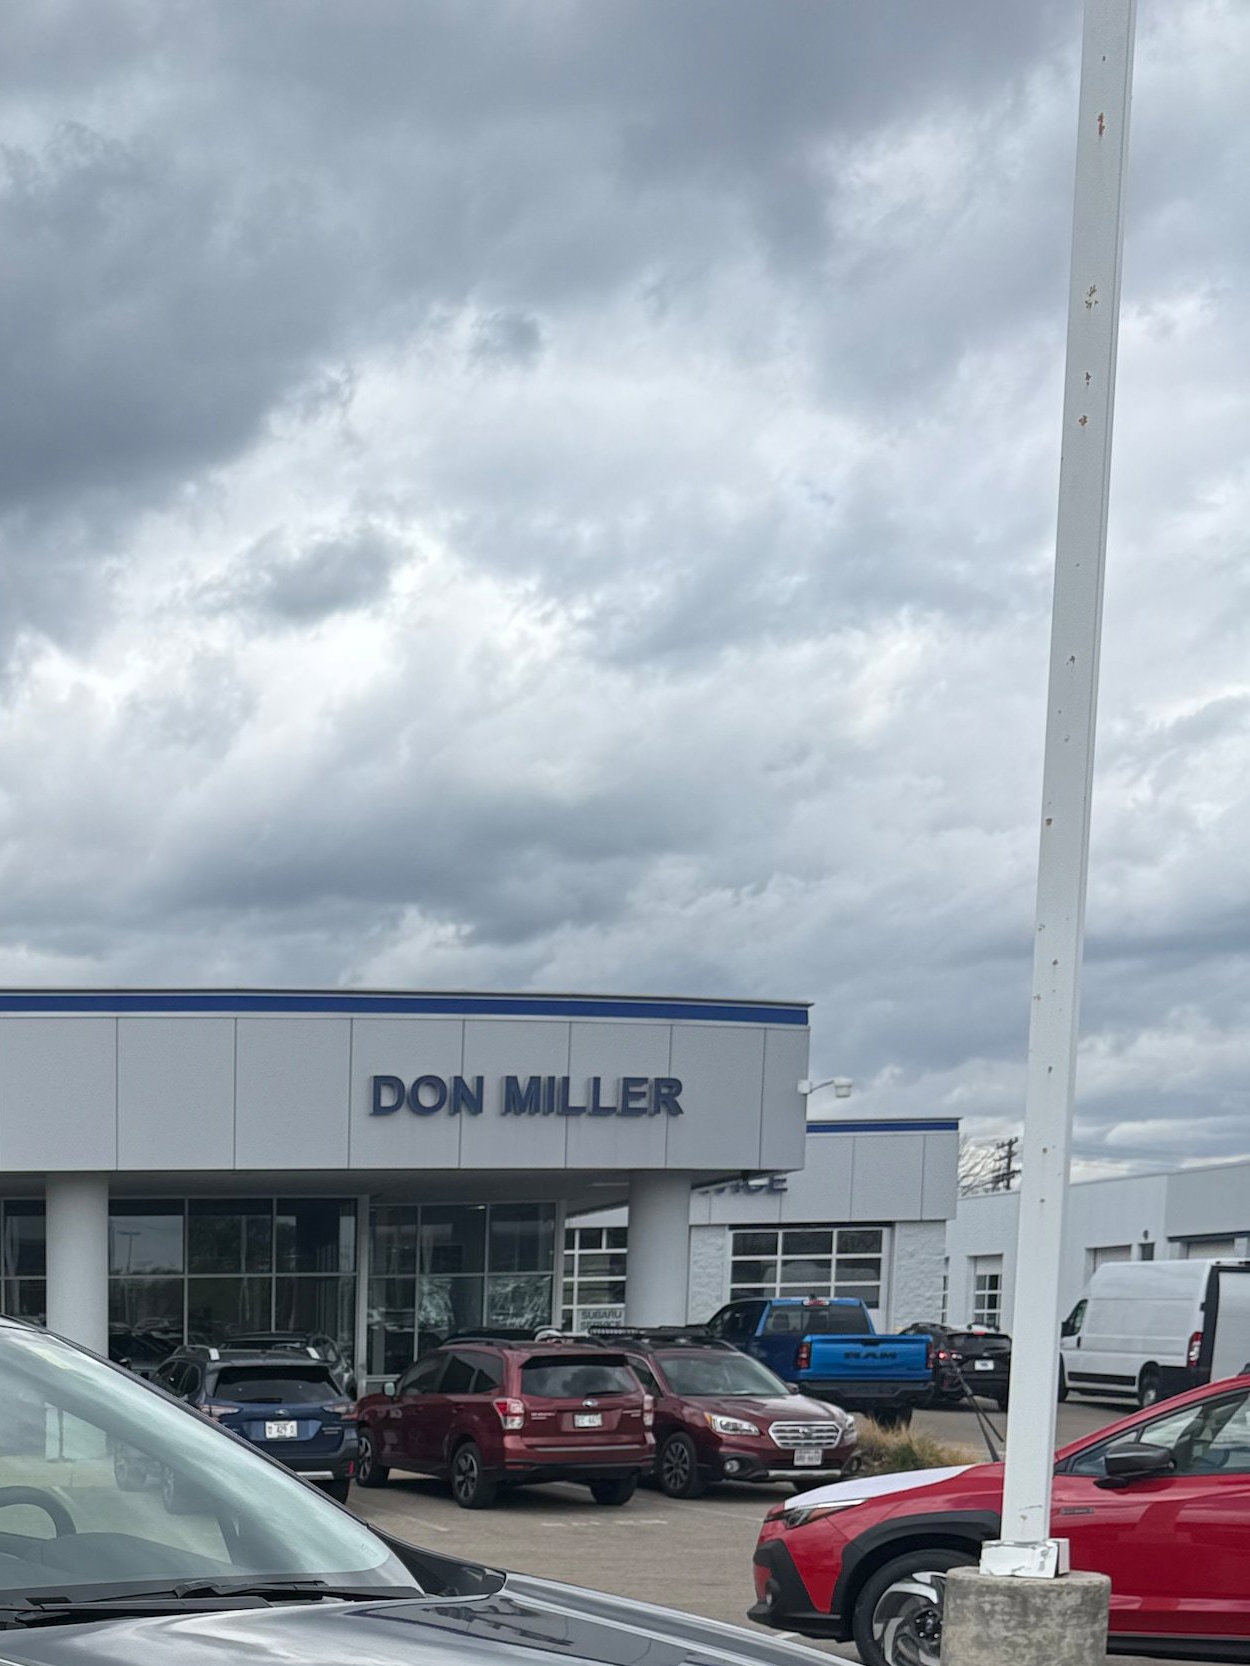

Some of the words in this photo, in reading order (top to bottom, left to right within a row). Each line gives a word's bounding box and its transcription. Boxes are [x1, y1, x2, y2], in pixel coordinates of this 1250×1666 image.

[370, 1075, 485, 1116] DON
[501, 1075, 685, 1117] MILLER
[581, 1310, 623, 1320] SUBARU
